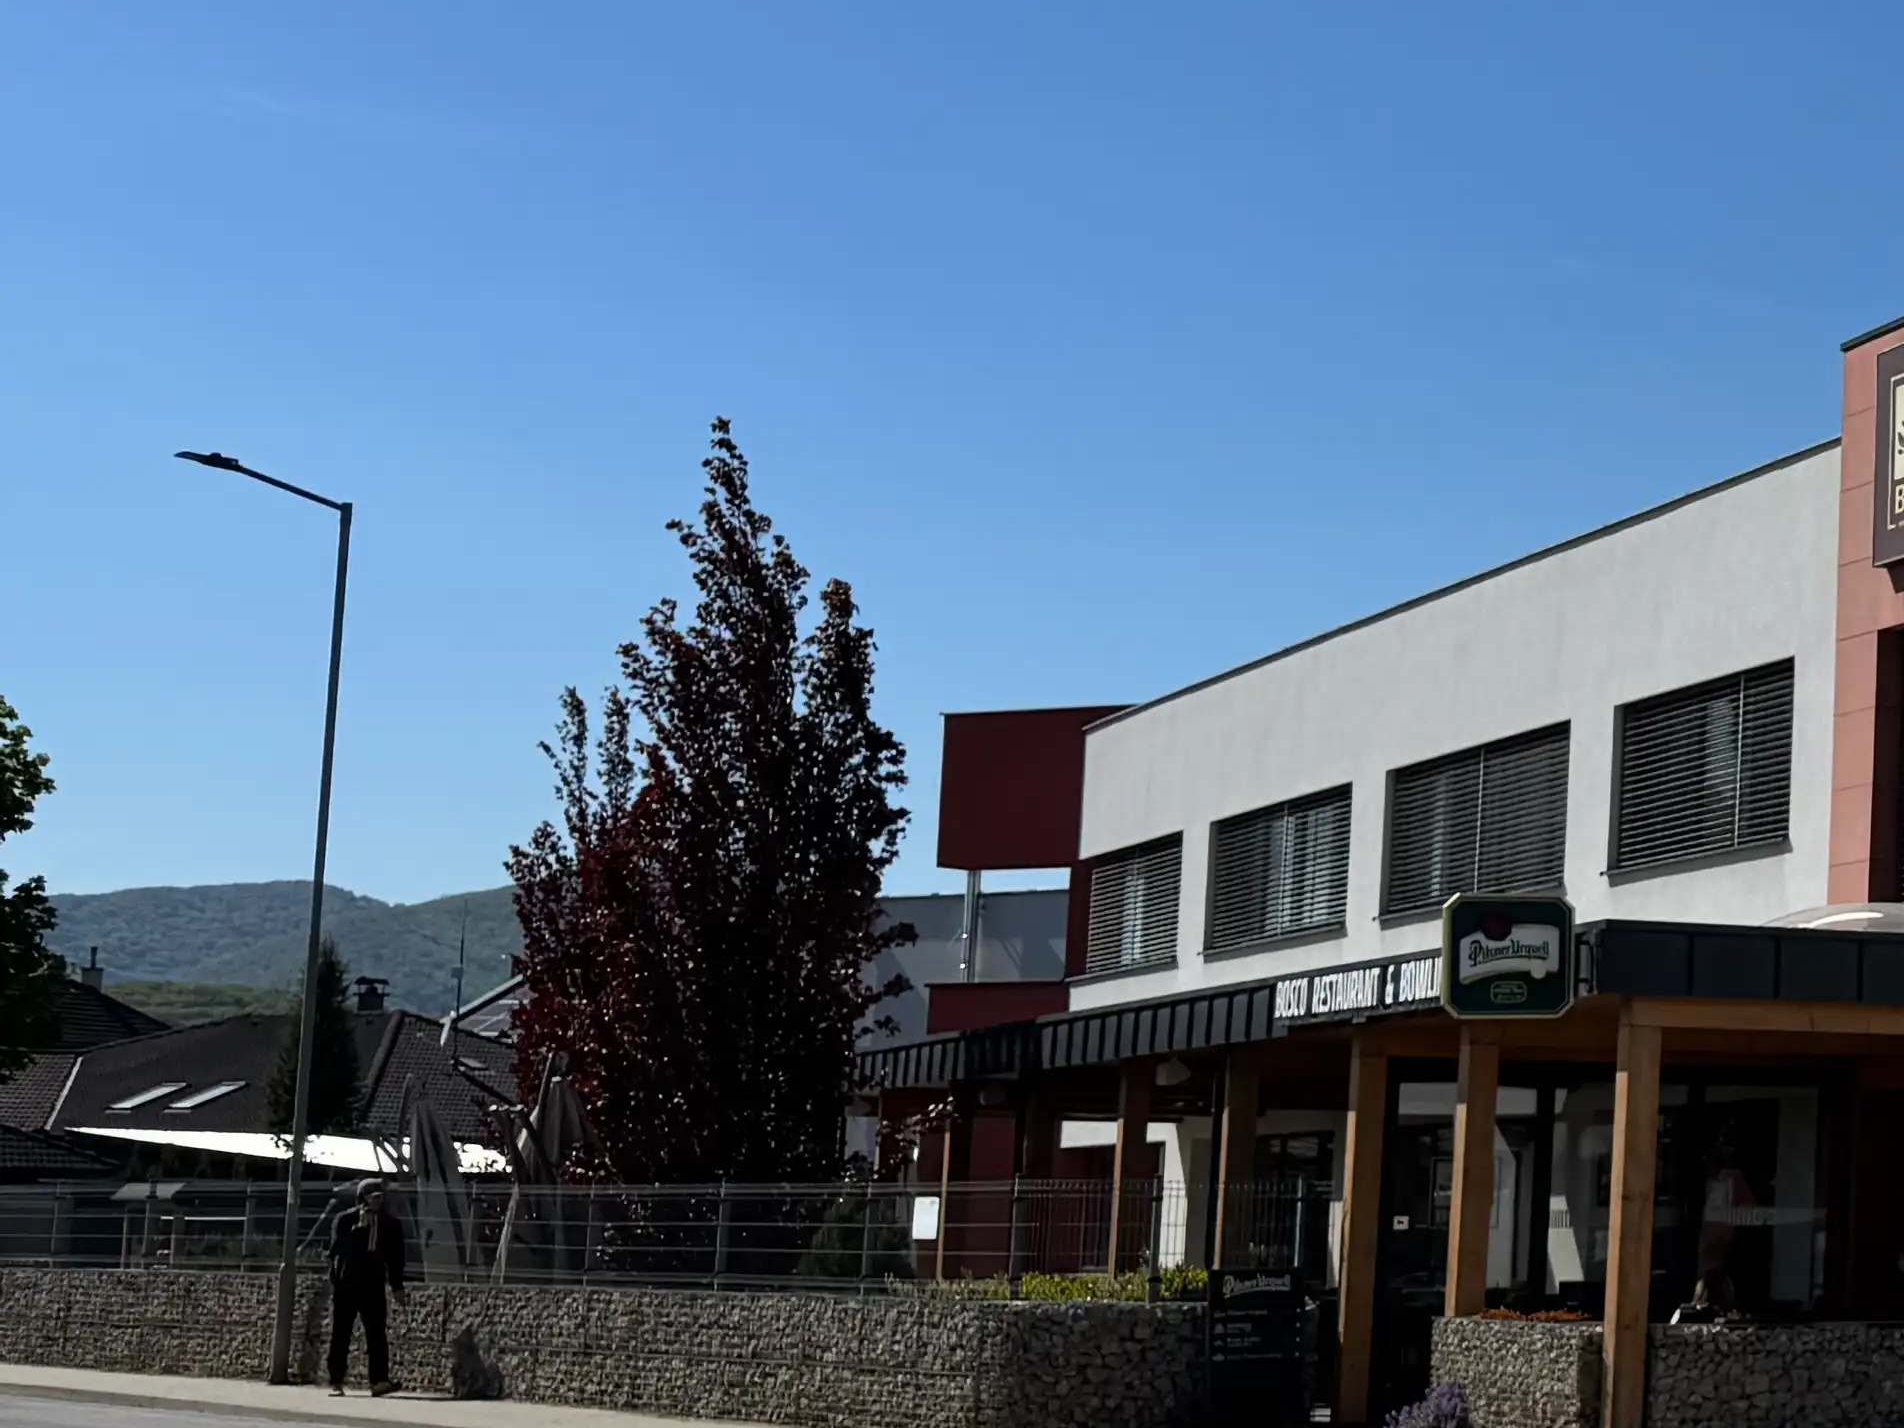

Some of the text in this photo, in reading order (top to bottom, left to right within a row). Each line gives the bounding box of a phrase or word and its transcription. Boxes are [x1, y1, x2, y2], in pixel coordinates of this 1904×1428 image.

[1274, 977, 1309, 1018] BOSCO
[1311, 967, 1381, 1014] RESTAURANT
[1385, 964, 1395, 1005] &
